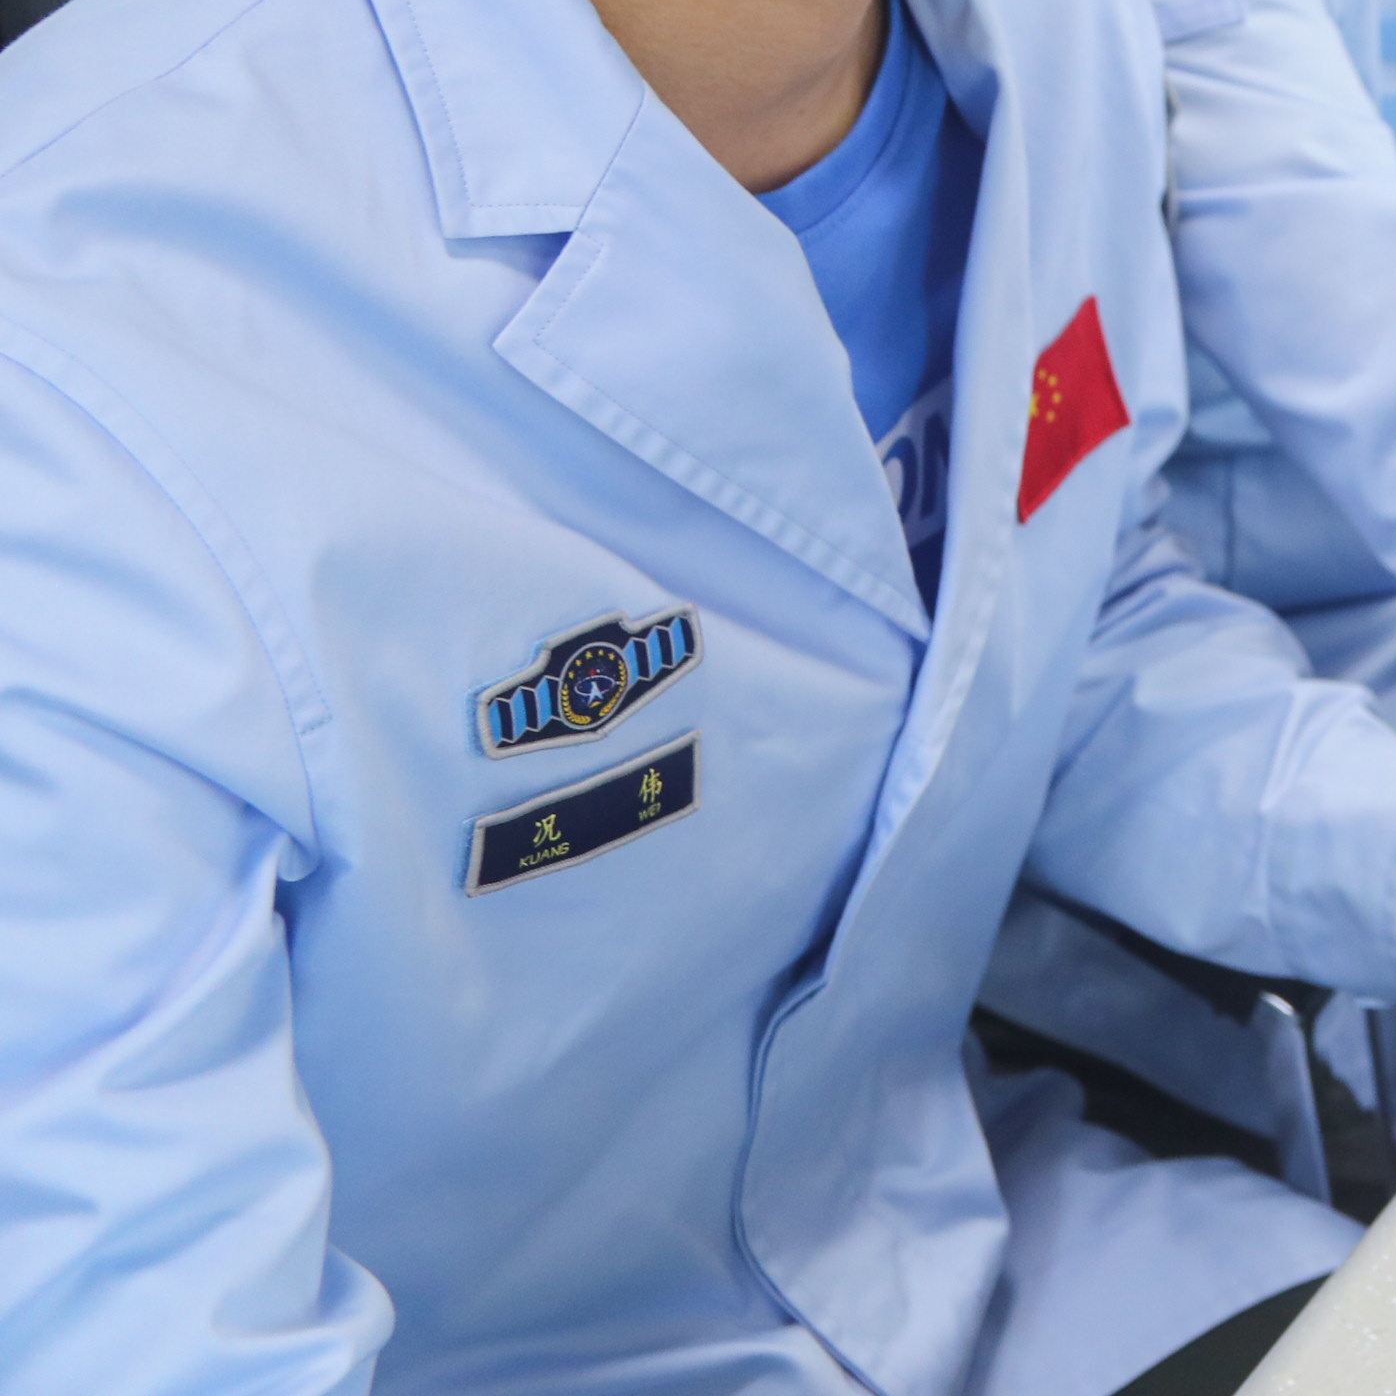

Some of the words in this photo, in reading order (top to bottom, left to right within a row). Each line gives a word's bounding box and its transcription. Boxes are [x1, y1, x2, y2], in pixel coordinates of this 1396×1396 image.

[519, 842, 570, 868] KUANG
[638, 802, 661, 821] WEI
[533, 814, 561, 848] 况
[638, 768, 663, 803] 伟
